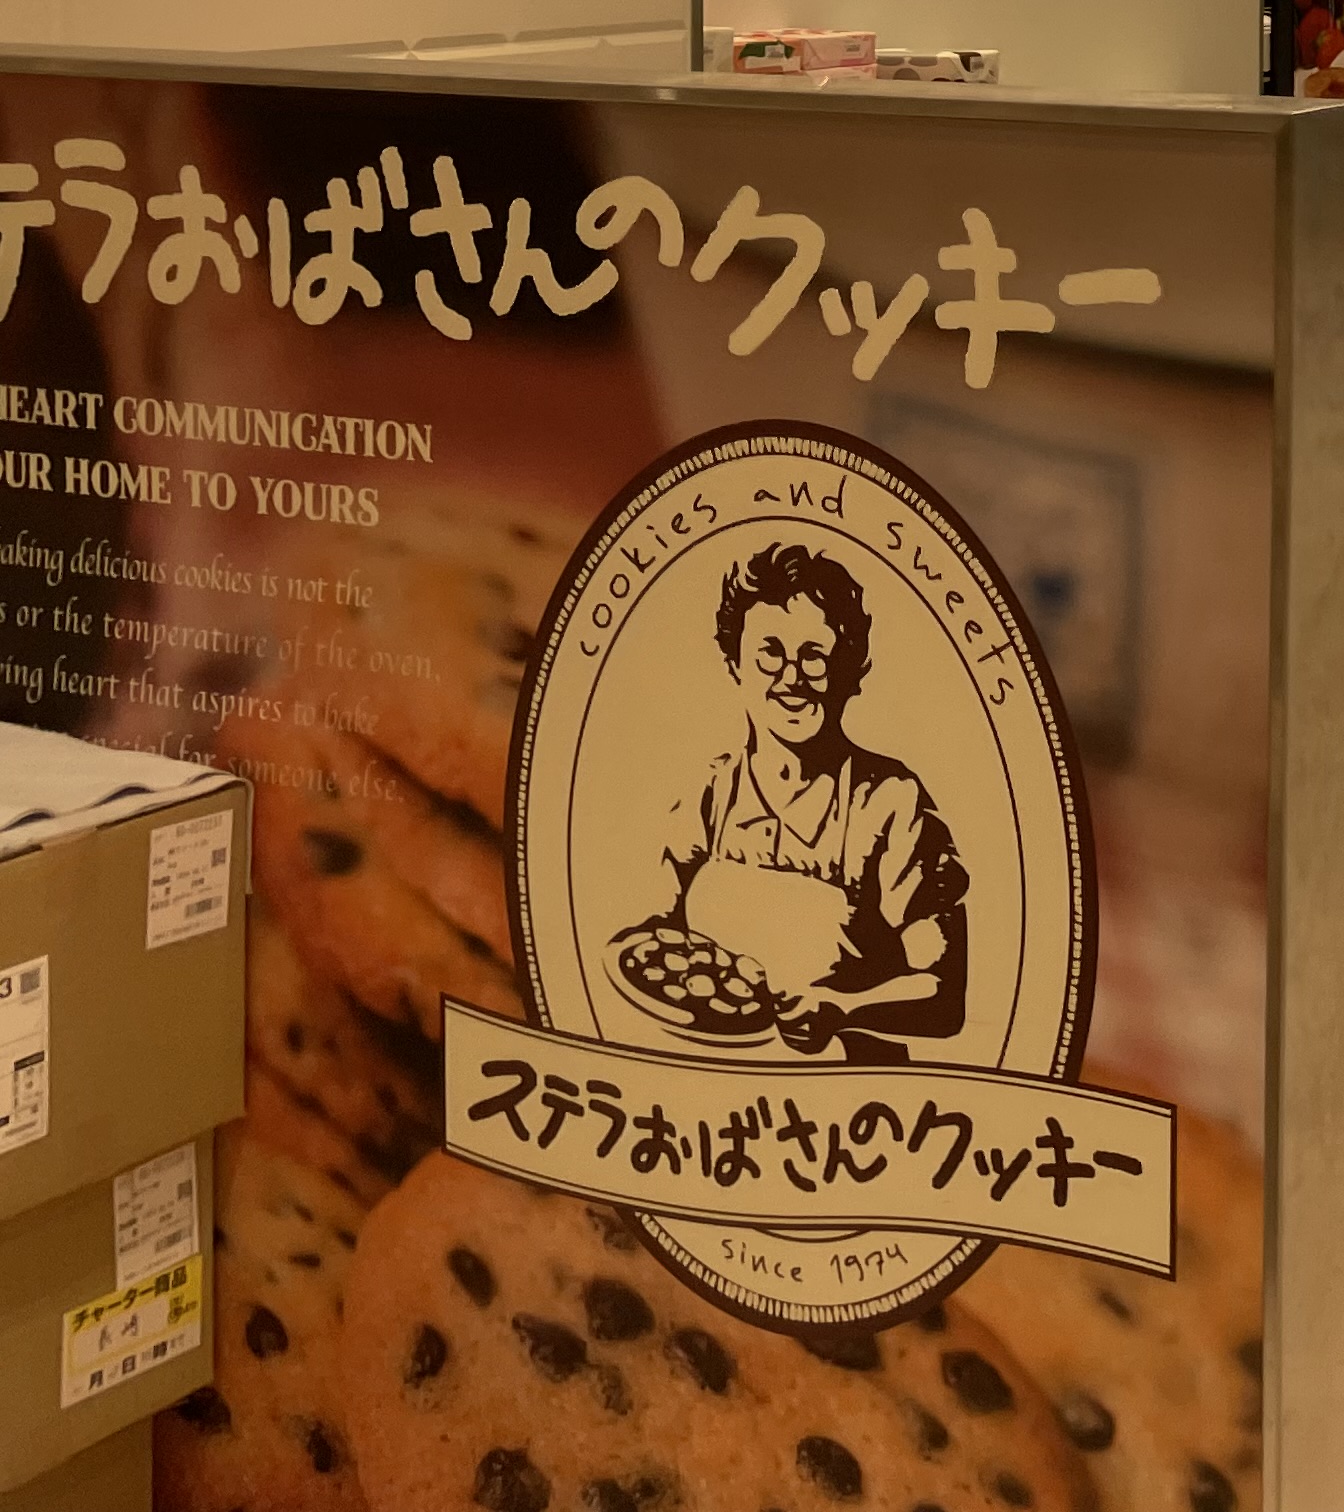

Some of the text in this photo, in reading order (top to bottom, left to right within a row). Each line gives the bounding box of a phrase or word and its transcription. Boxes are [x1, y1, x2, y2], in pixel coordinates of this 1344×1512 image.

[113, 396, 434, 463] COMMUNICATION
[64, 458, 171, 504] HOME
[183, 470, 236, 511] TO
[249, 477, 379, 527] YOURS
[70, 538, 166, 584] delicious
[173, 553, 252, 595] cookies
[261, 568, 278, 597] is
[287, 575, 327, 604] not
[336, 568, 373, 608] the
[580, 475, 1019, 707] cookies and sweets
[16, 604, 43, 627] or
[52, 596, 92, 635] the
[103, 612, 267, 660] temperature
[316, 629, 357, 669] the
[52, 654, 119, 699] heart
[129, 667, 184, 709] that
[193, 686, 282, 730] aspires
[469, 1059, 1143, 1207] ステラおばさんのクッキー
[720, 1238, 909, 1284] since 1974
